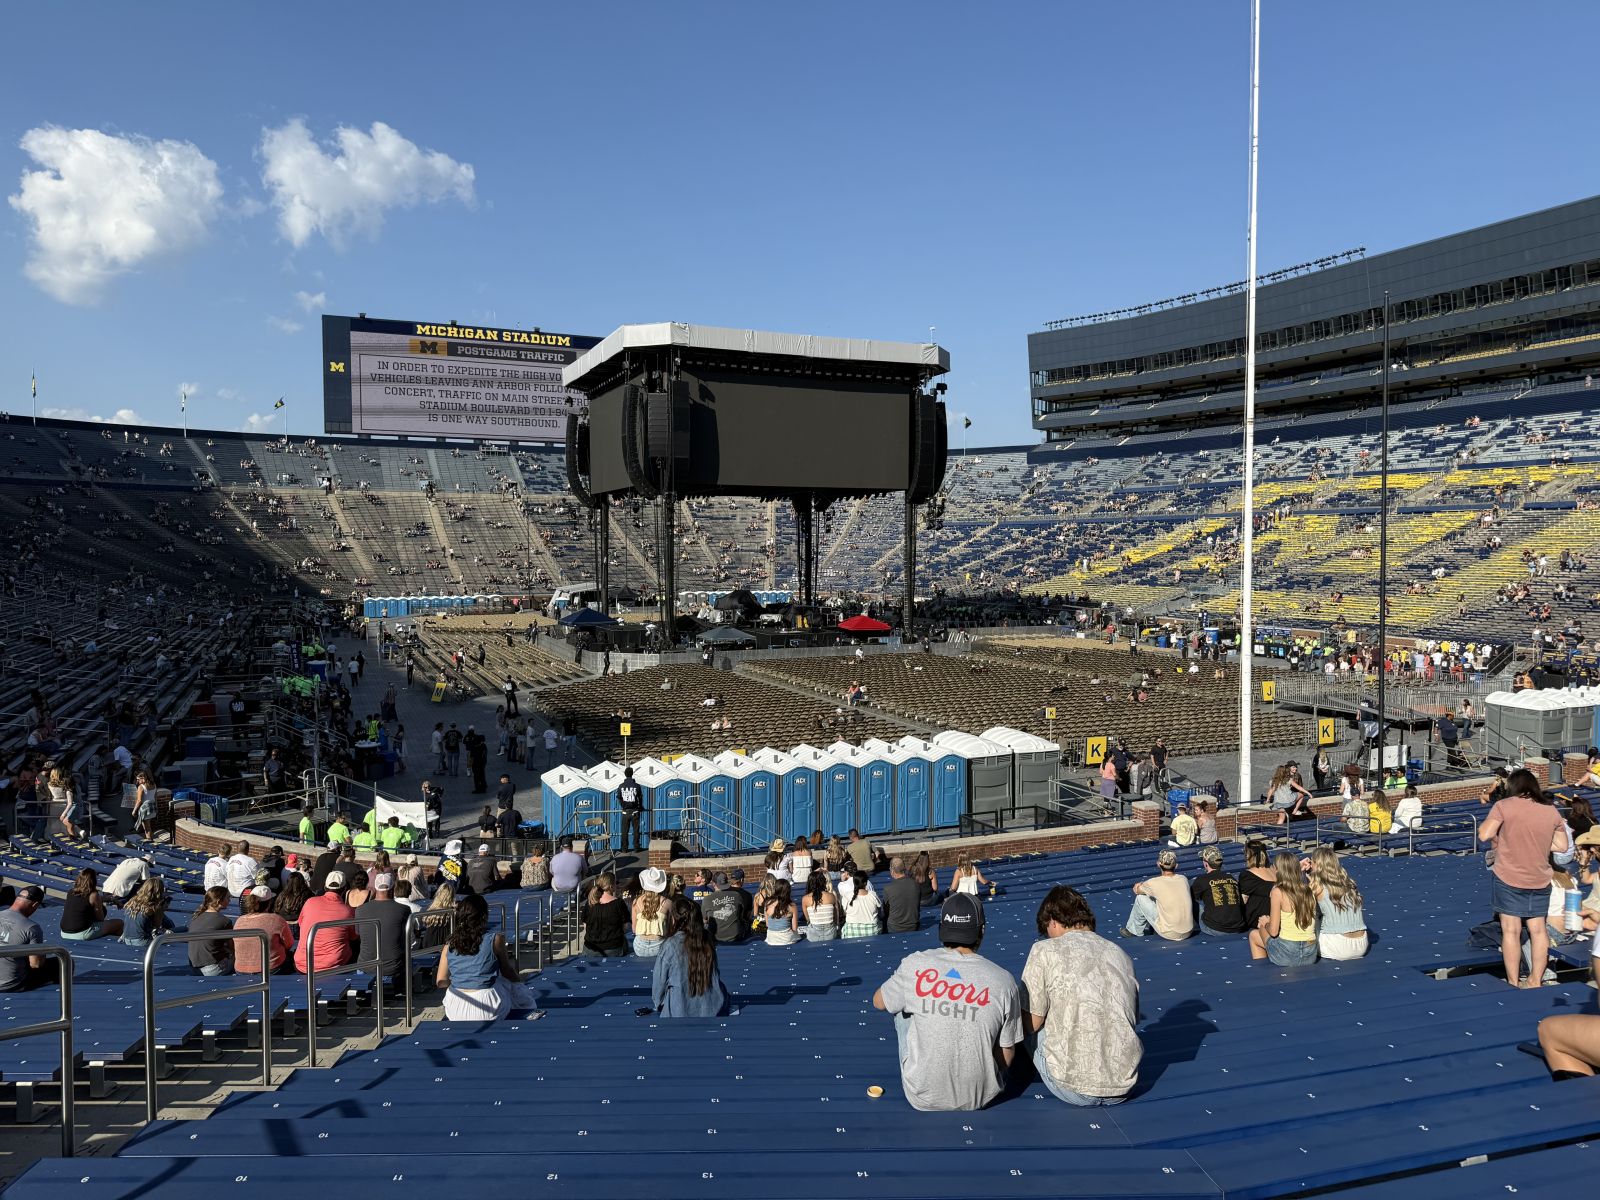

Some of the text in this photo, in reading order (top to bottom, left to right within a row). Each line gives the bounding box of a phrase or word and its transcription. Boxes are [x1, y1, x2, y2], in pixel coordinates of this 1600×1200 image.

[416, 324, 571, 346] MICHIGAN STADIUM
[420, 341, 438, 354] M
[457, 345, 565, 362] POSTGAME TRAFFIC
[329, 361, 345, 373] M
[377, 360, 562, 382] IN ORDER TO EXPEDITE THE HIGH VO
[370, 373, 422, 385] VEHICLES
[425, 376, 470, 387] LEAVING
[472, 379, 494, 390] ANN
[496, 381, 531, 392] ARBOR
[384, 386, 436, 399] CONCERT,
[438, 389, 482, 401] TRAFFIC
[484, 392, 499, 402] ON
[501, 393, 529, 404] MAIN
[572, 397, 589, 407] FRO
[419, 400, 468, 413] STADIUM
[470, 403, 531, 416] BOULEVARD
[532, 407, 546, 416] TO
[427, 413, 561, 429] IS ONE WAY SOUTHBOUND.
[1266, 686, 1273, 697] J
[1322, 724, 1331, 738] K
[1091, 743, 1102, 758] K
[915, 968, 990, 1007] Coors
[921, 998, 980, 1022] LIGHT
[80, 1176, 90, 1184] 9
[546, 1173, 558, 1181] 12
[856, 1170, 869, 1178] 14
[1504, 1184, 1518, 1193] 2
